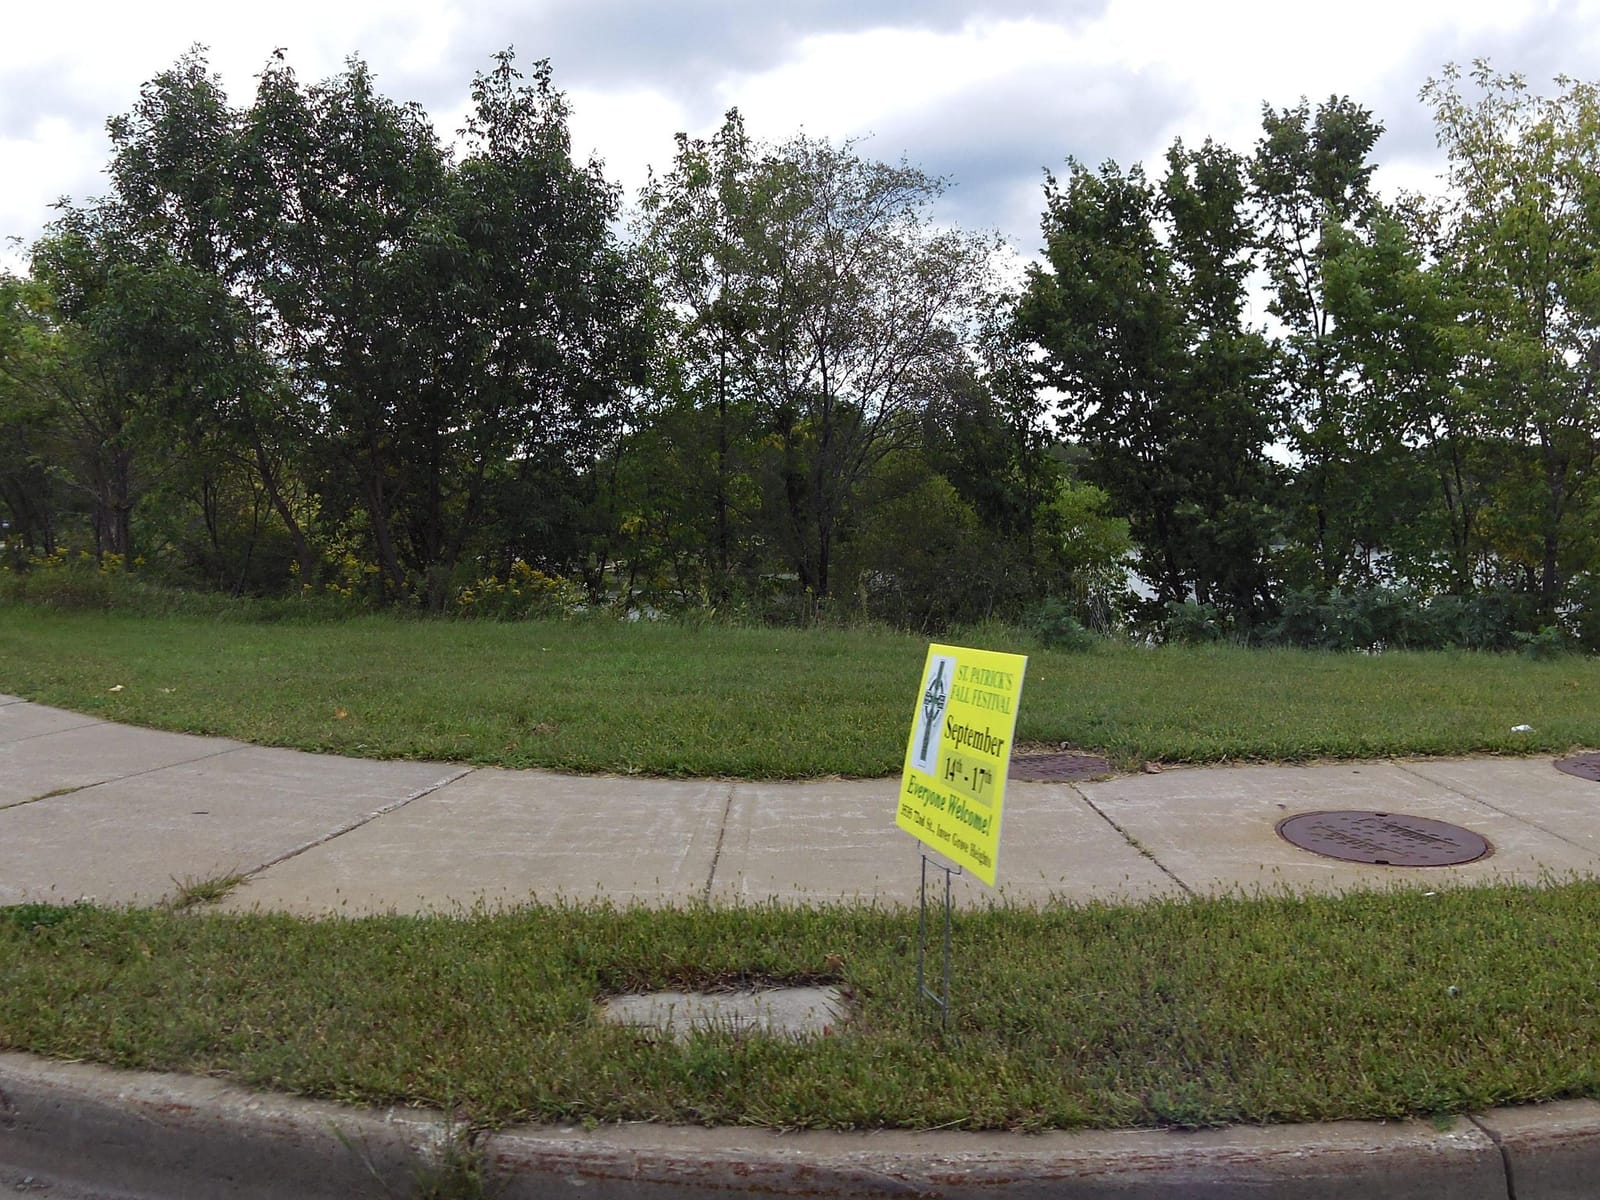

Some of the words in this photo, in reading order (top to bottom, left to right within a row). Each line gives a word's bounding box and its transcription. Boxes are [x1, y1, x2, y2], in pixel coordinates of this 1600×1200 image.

[957, 665, 969, 681] ST.
[969, 667, 1014, 691] PATRICK'S
[950, 684, 970, 704] FALL
[971, 689, 1011, 715] FESTIVAL
[944, 714, 1005, 757] September
[944, 757, 962, 782] 14th
[971, 767, 992, 794] 17th
[906, 775, 946, 811] Everyone
[947, 794, 993, 837] Welcome!
[936, 823, 951, 842] Inver
[952, 832, 969, 853] Grove
[969, 843, 992, 869] Heights
